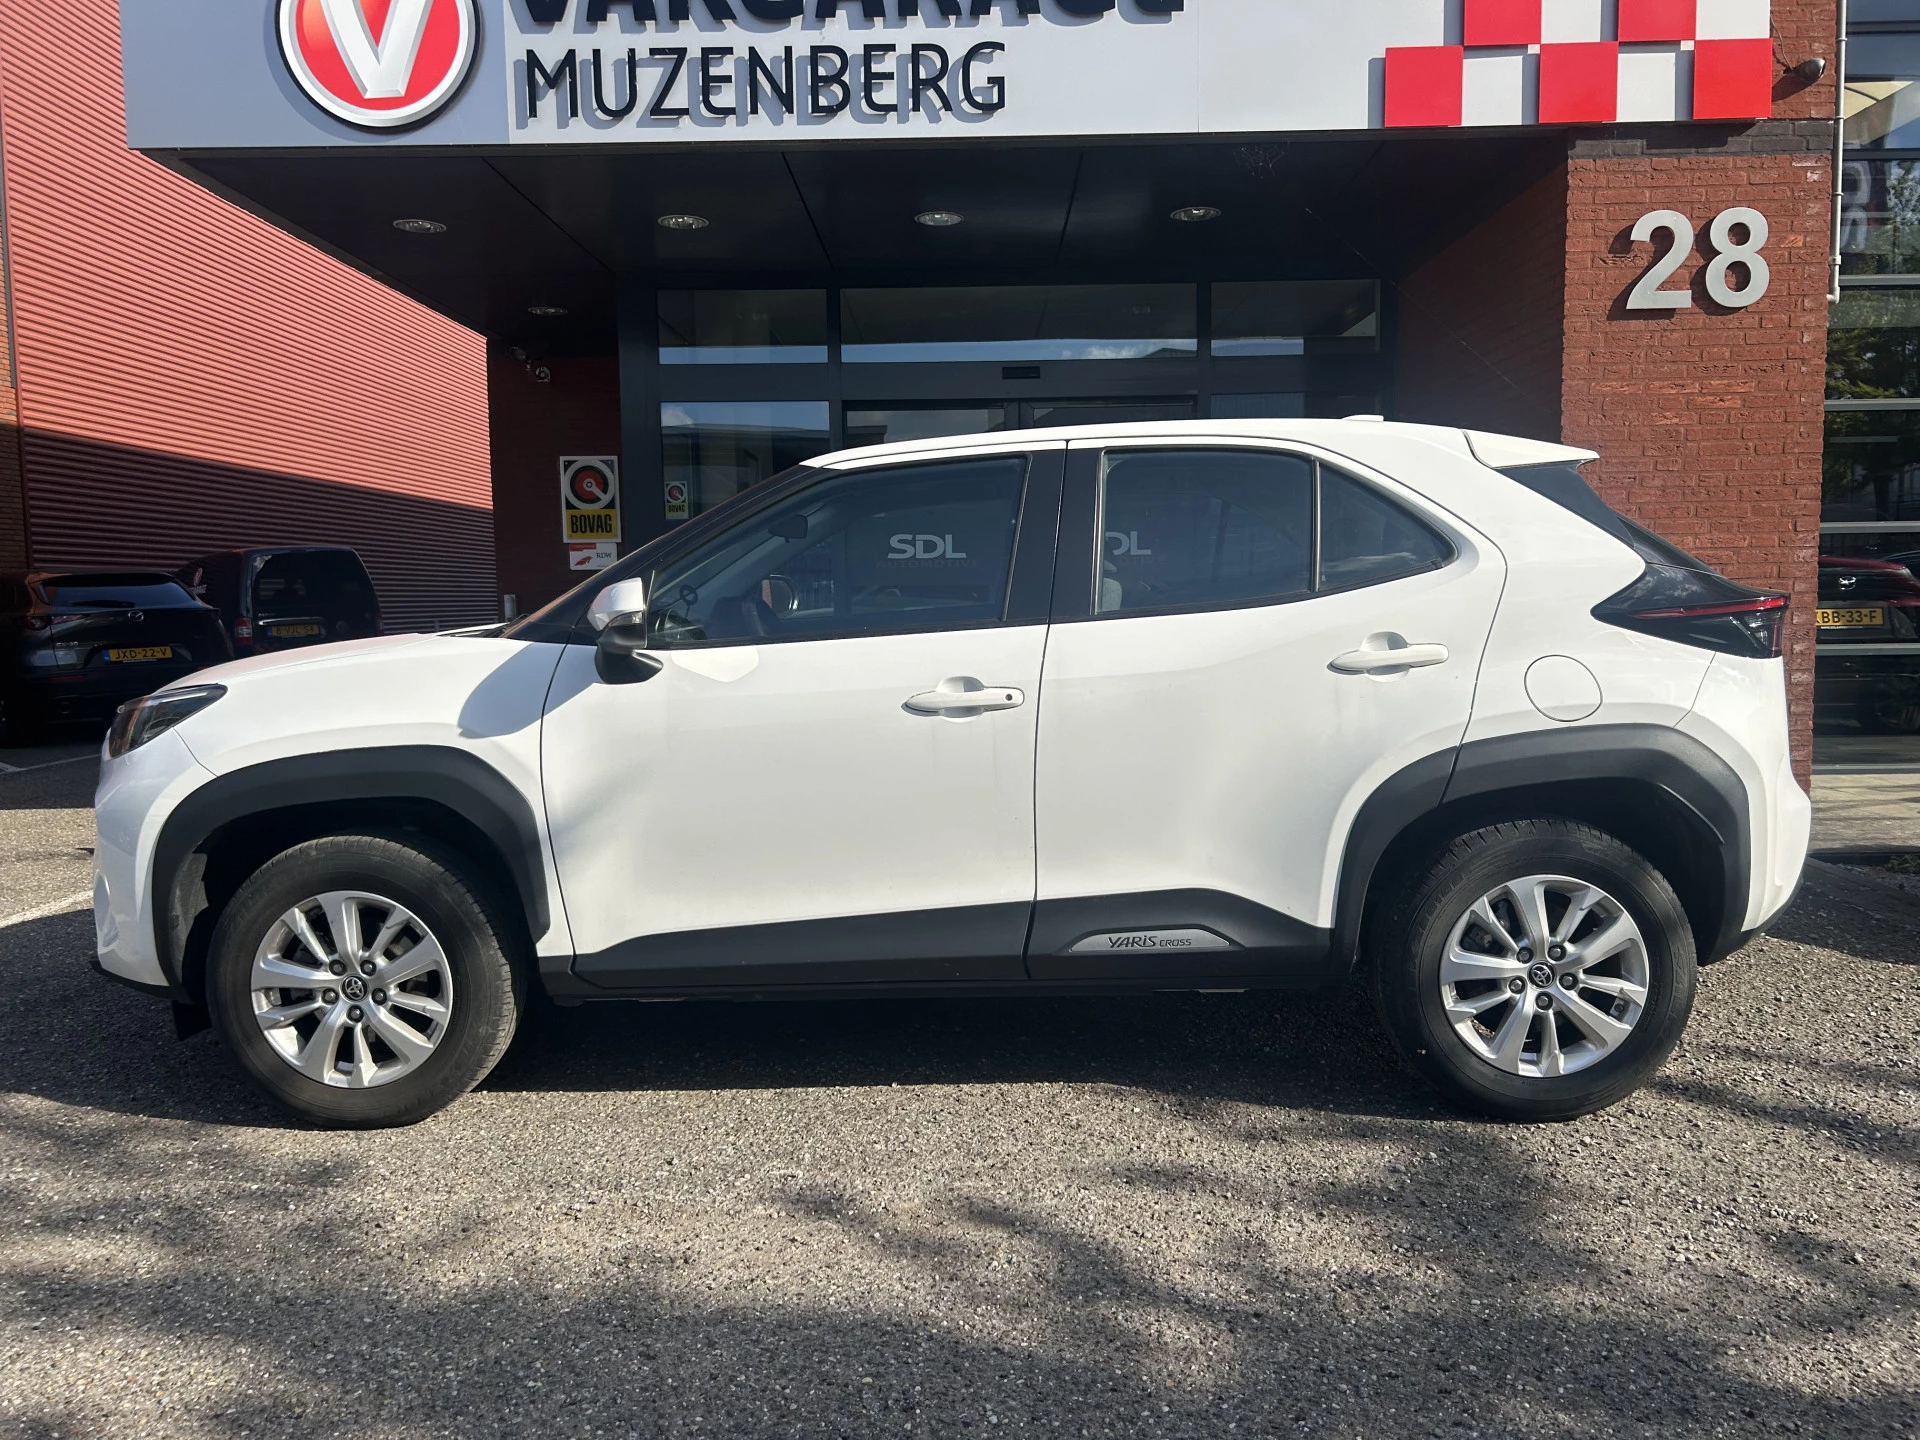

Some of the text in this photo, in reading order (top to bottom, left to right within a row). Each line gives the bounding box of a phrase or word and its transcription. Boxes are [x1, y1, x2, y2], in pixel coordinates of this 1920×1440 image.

[526, 41, 1005, 118] MUZENBERG
[1626, 207, 1770, 309] 28
[668, 504, 685, 512] BOVAG
[571, 514, 612, 533] BOVAG
[888, 533, 967, 559] SDL
[876, 559, 981, 569] AUTOMOTIVE
[115, 648, 167, 660] JXD-22-V
[1159, 938, 1192, 947] CROSS
